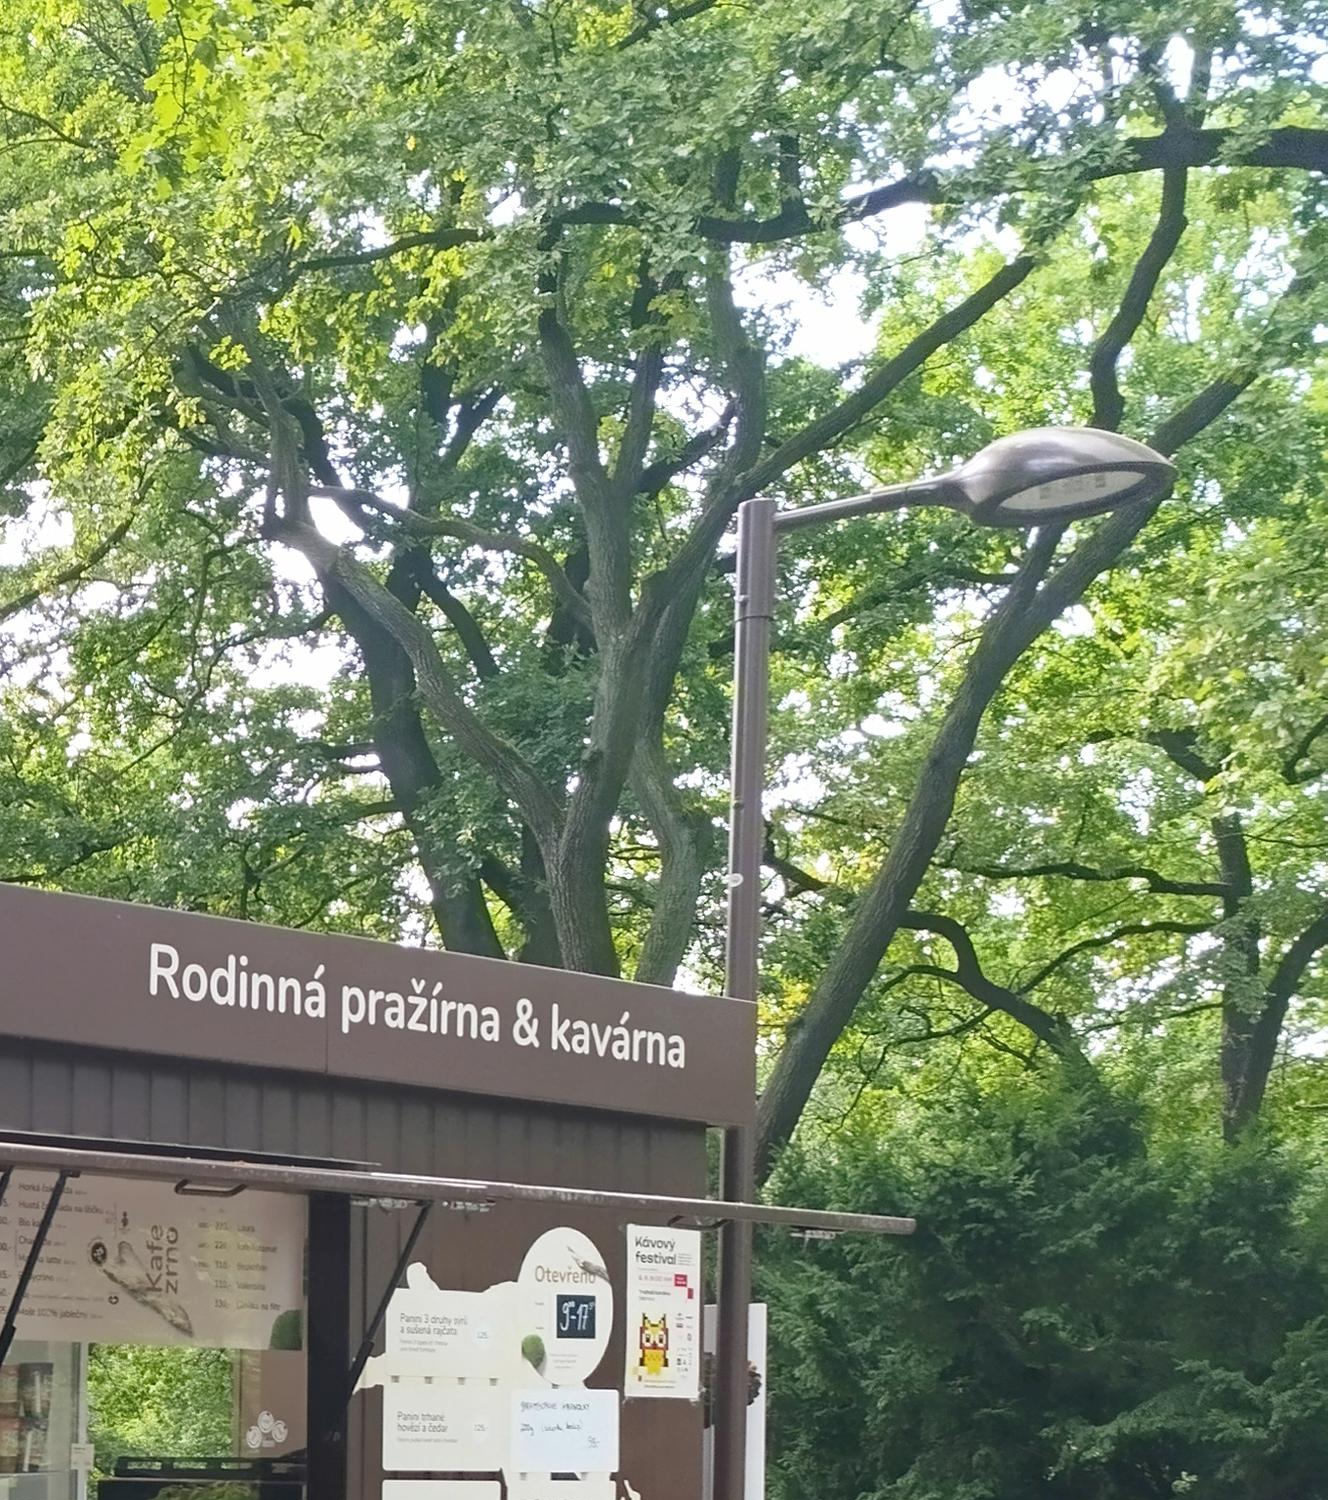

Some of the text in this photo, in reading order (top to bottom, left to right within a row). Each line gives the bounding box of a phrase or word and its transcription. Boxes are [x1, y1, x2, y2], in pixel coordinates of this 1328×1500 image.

[148, 943, 686, 1071] Rodinná pražírna & kavárna
[146, 1225, 164, 1293] Kafe
[165, 1226, 179, 1295] zrno
[635, 1236, 676, 1252] Kávový
[635, 1250, 677, 1265] festival
[534, 1265, 597, 1285] Otevřeno
